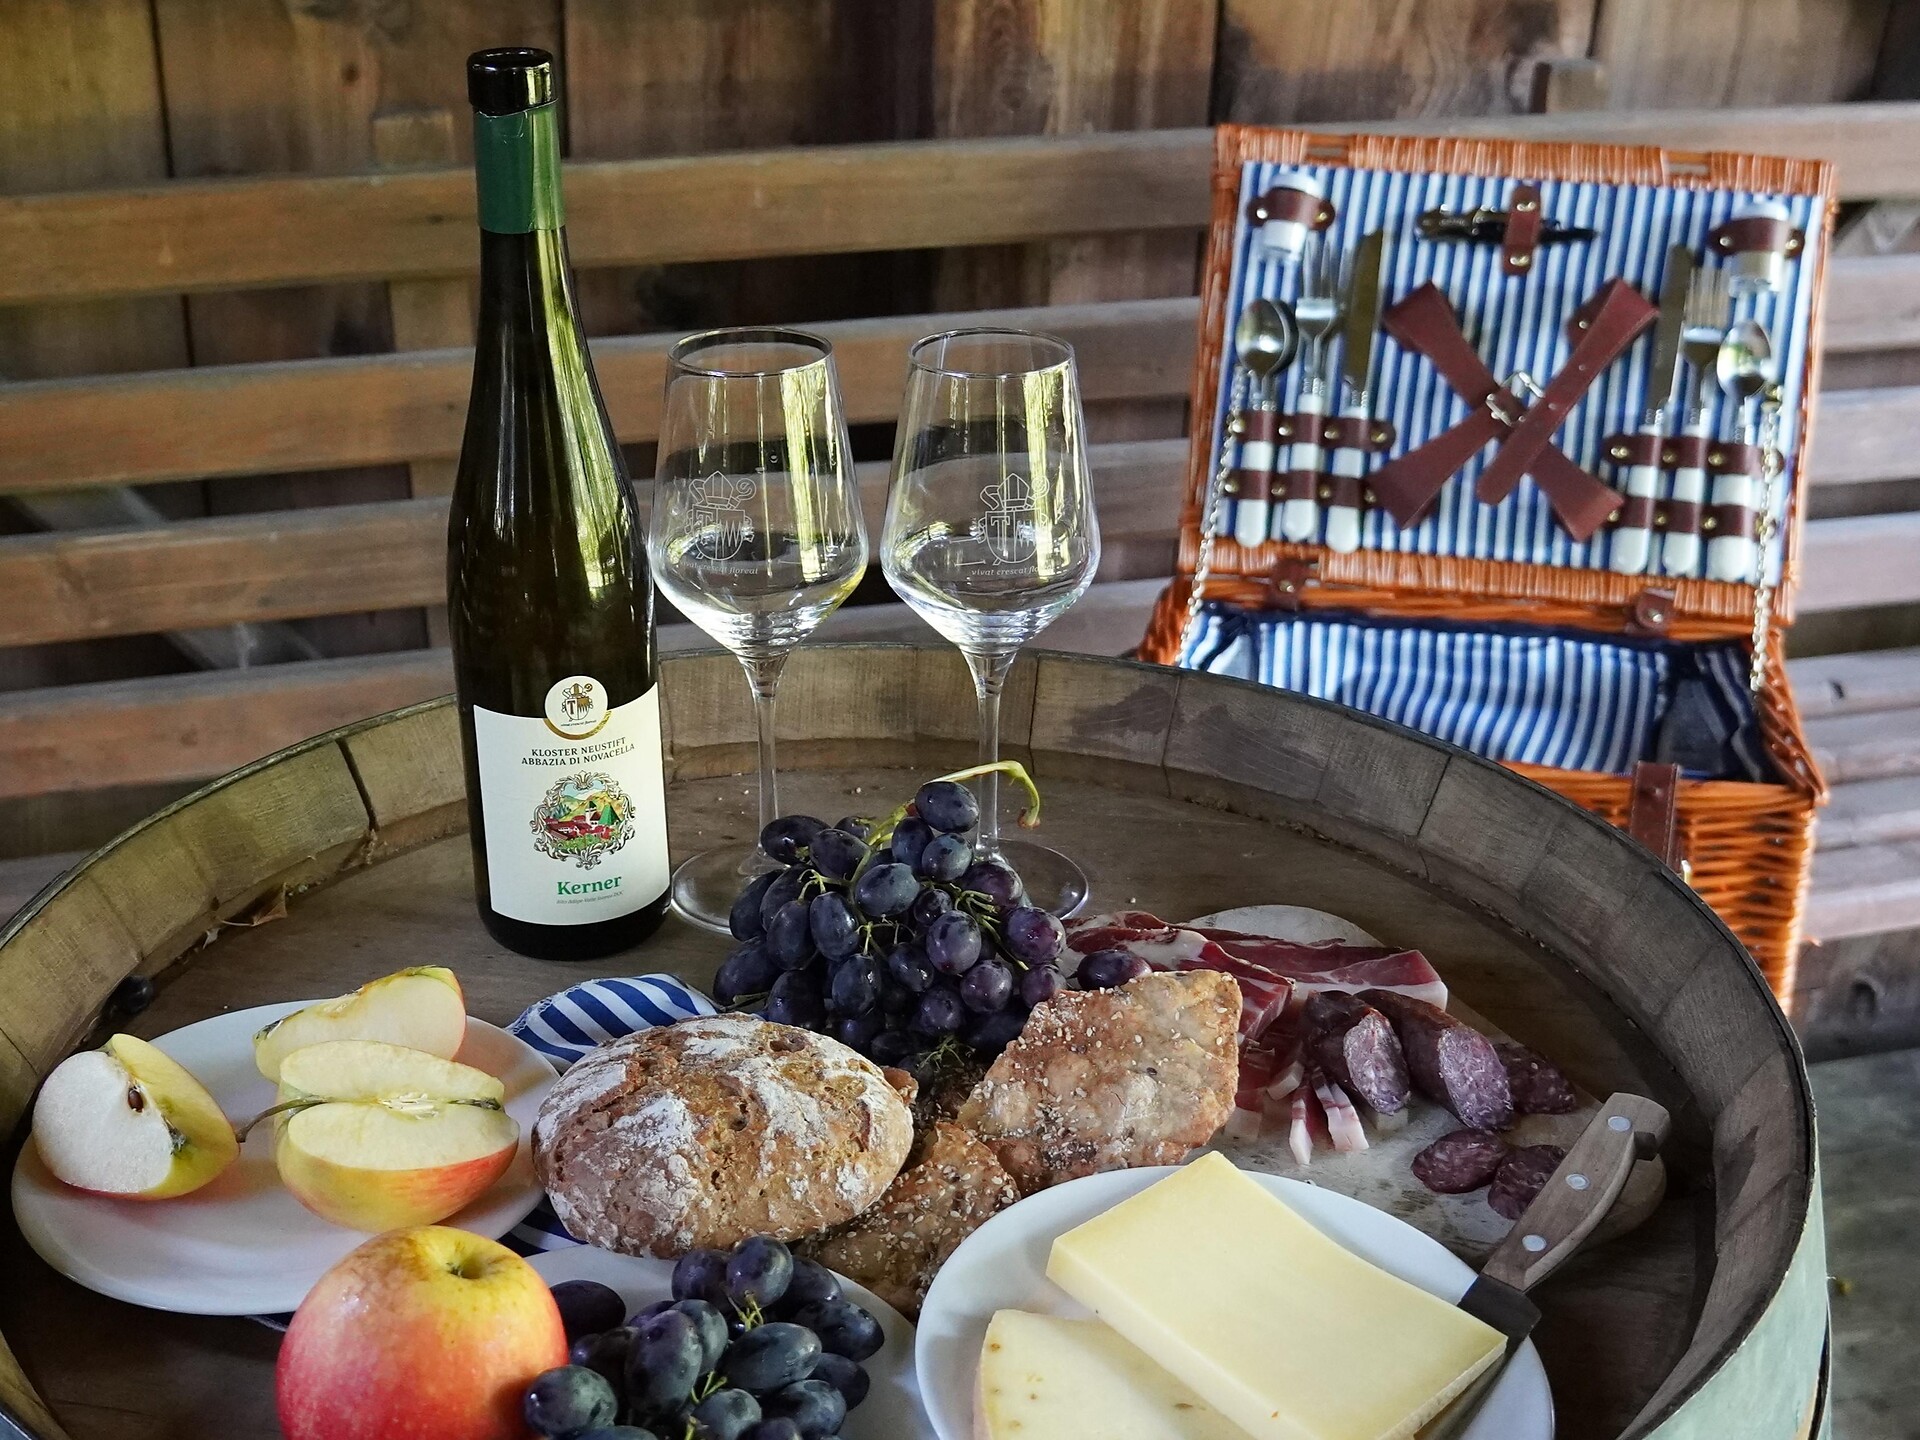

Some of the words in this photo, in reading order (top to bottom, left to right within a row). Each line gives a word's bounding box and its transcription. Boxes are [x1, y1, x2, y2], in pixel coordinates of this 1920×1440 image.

[972, 568, 994, 576] vivat
[997, 567, 1027, 576] crescat
[567, 700, 576, 715] T
[521, 757, 566, 766] ABBAZIA
[569, 757, 580, 765] DI
[584, 743, 635, 763] NOVACELLA
[531, 748, 578, 757] KLOSTER
[581, 737, 626, 754] NEUSTIFT
[557, 876, 622, 895] Kerner
